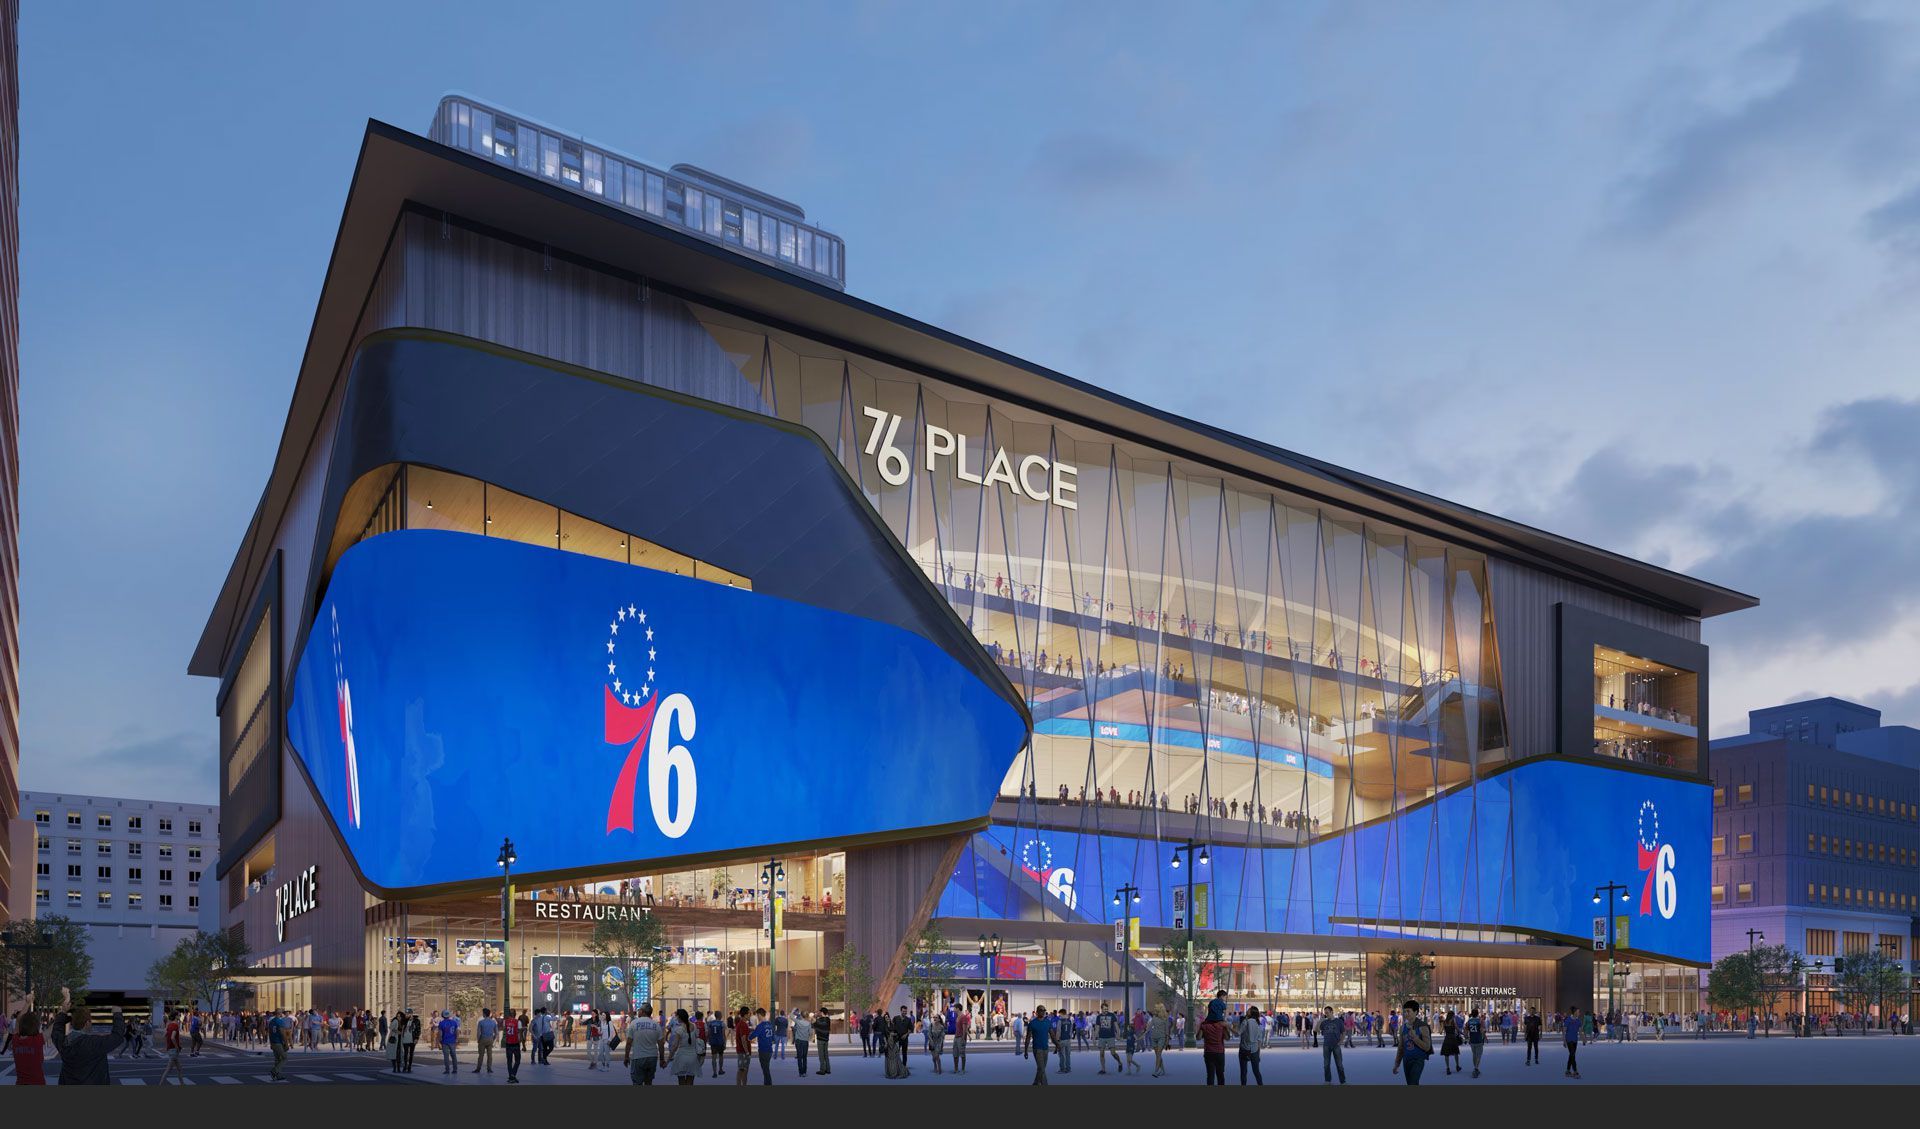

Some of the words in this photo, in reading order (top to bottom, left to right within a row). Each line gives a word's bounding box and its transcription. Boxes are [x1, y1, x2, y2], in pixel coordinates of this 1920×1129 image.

[863, 406, 910, 486] 76
[926, 424, 1078, 510] PLACE
[604, 683, 698, 839] 76
[283, 865, 316, 921] PLACE
[1637, 840, 1677, 919] 76
[536, 902, 651, 921] RESTAURANT
[1062, 980, 1077, 989] BOX
[1079, 980, 1104, 989] OFFICE
[1439, 986, 1467, 995] MARKET
[1470, 987, 1479, 995] ST
[1481, 987, 1516, 996] ENTRANCE
[765, 1028, 773, 1037] 21
